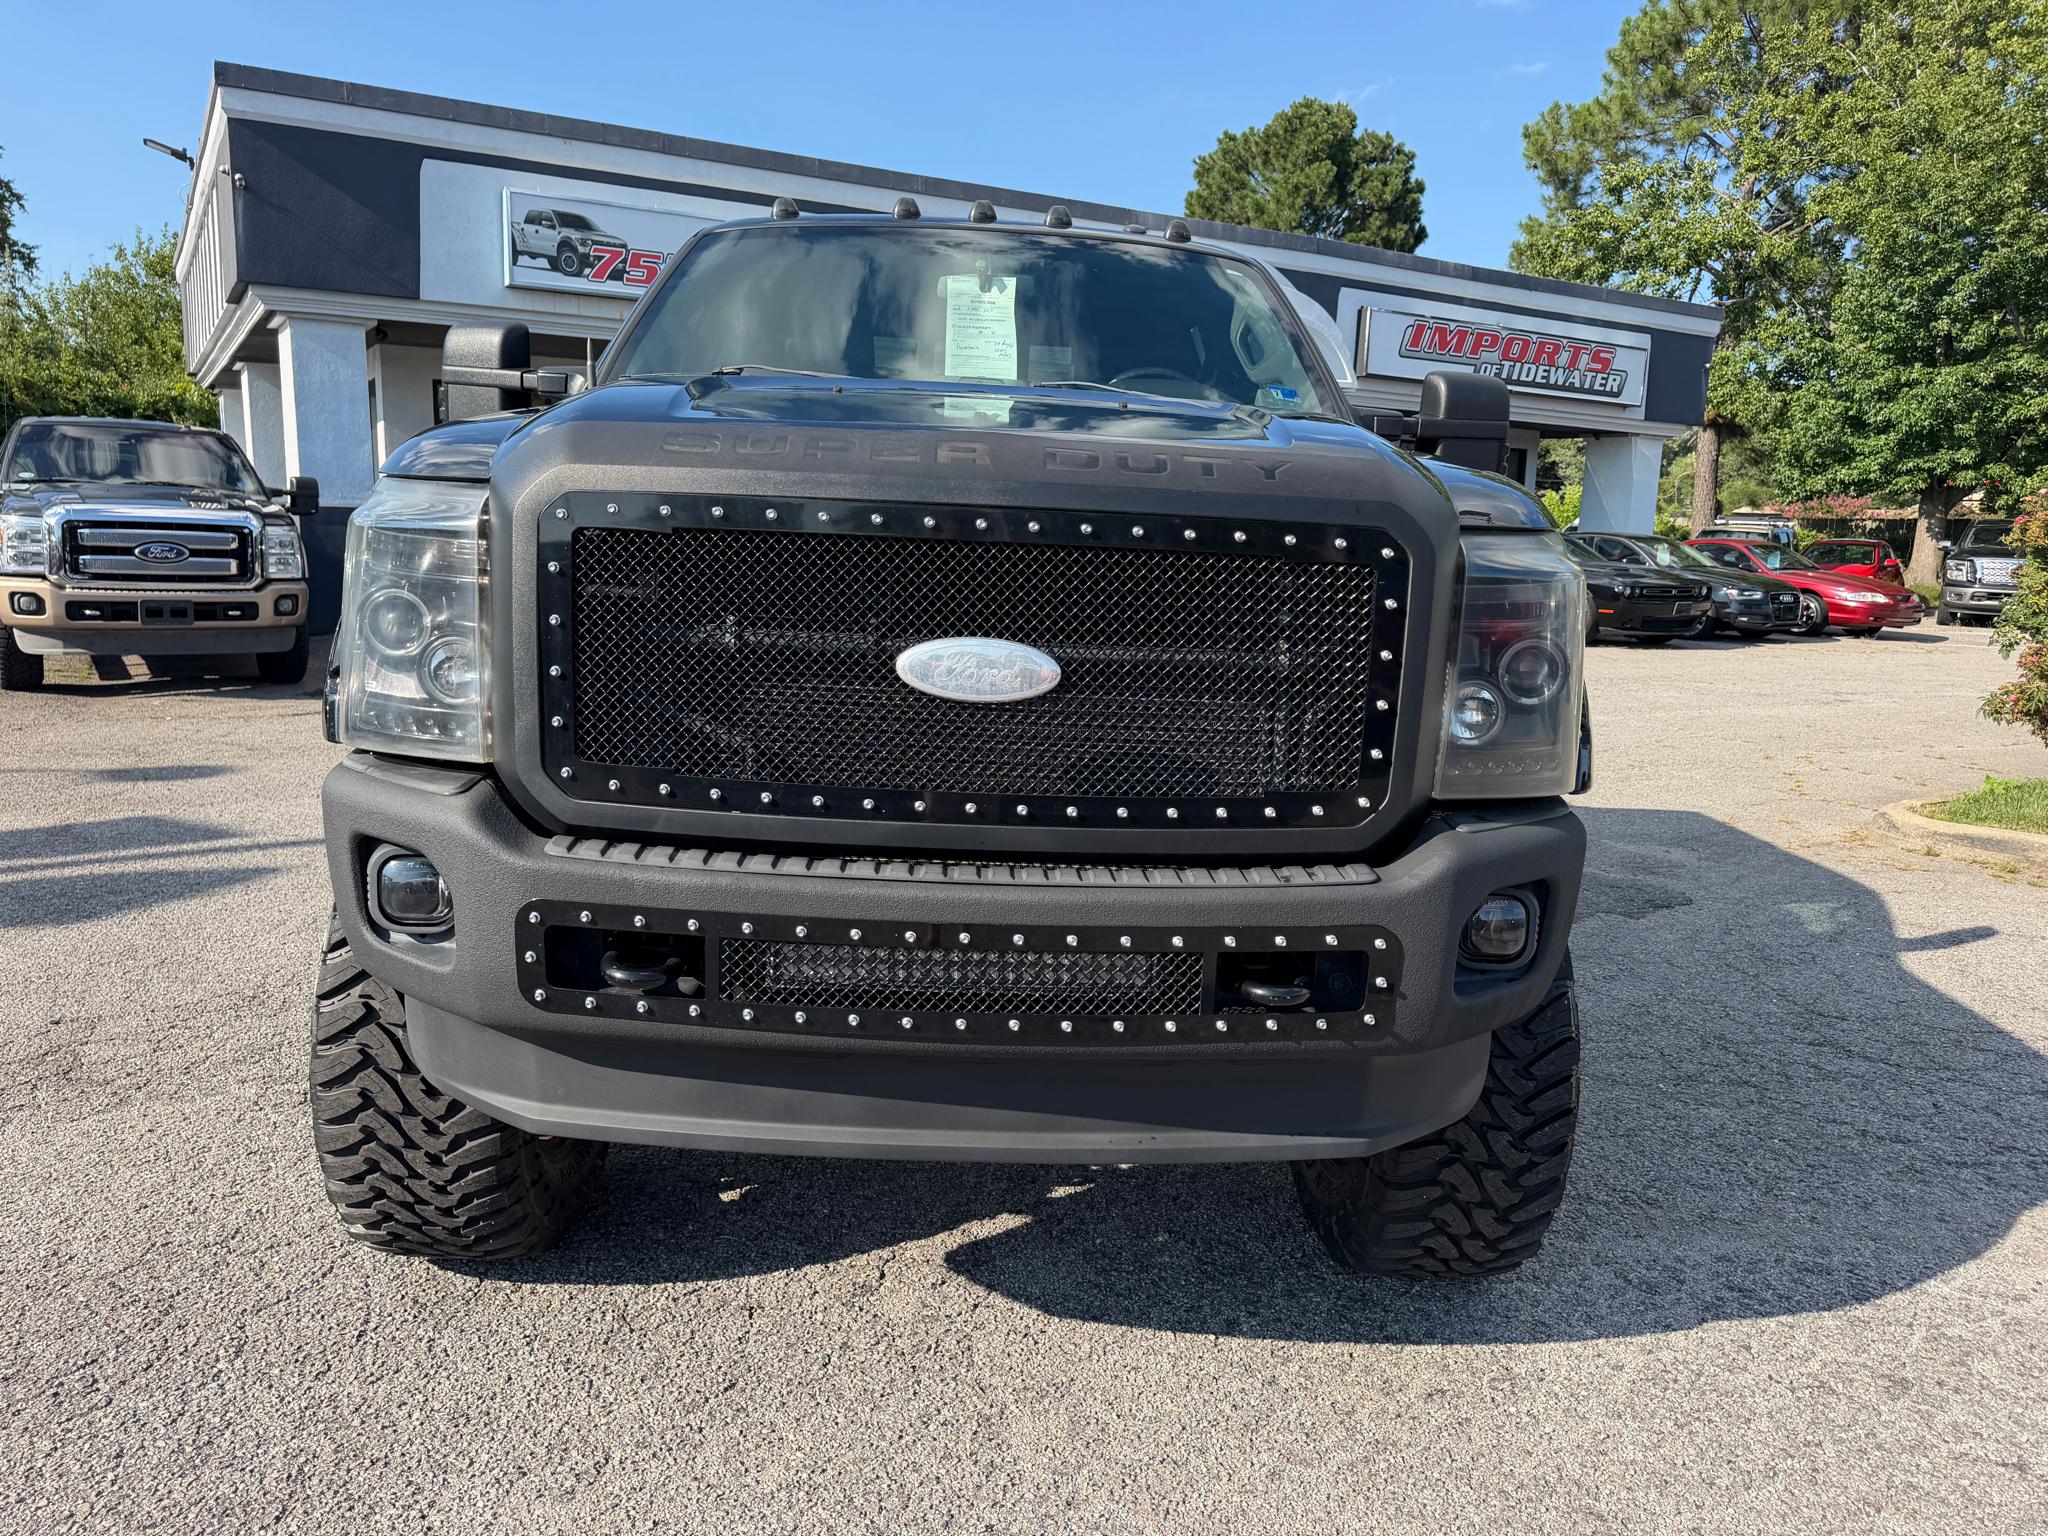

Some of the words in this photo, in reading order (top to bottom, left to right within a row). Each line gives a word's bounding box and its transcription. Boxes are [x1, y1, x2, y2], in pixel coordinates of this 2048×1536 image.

[587, 245, 676, 287] 75
[1404, 319, 1618, 374] IMPORTS
[1500, 361, 1623, 393] TIDEWATER
[659, 431, 991, 466] SUPER
[1044, 447, 1294, 482] DUTY
[148, 546, 177, 558] Ford
[933, 651, 1022, 688] Ford
